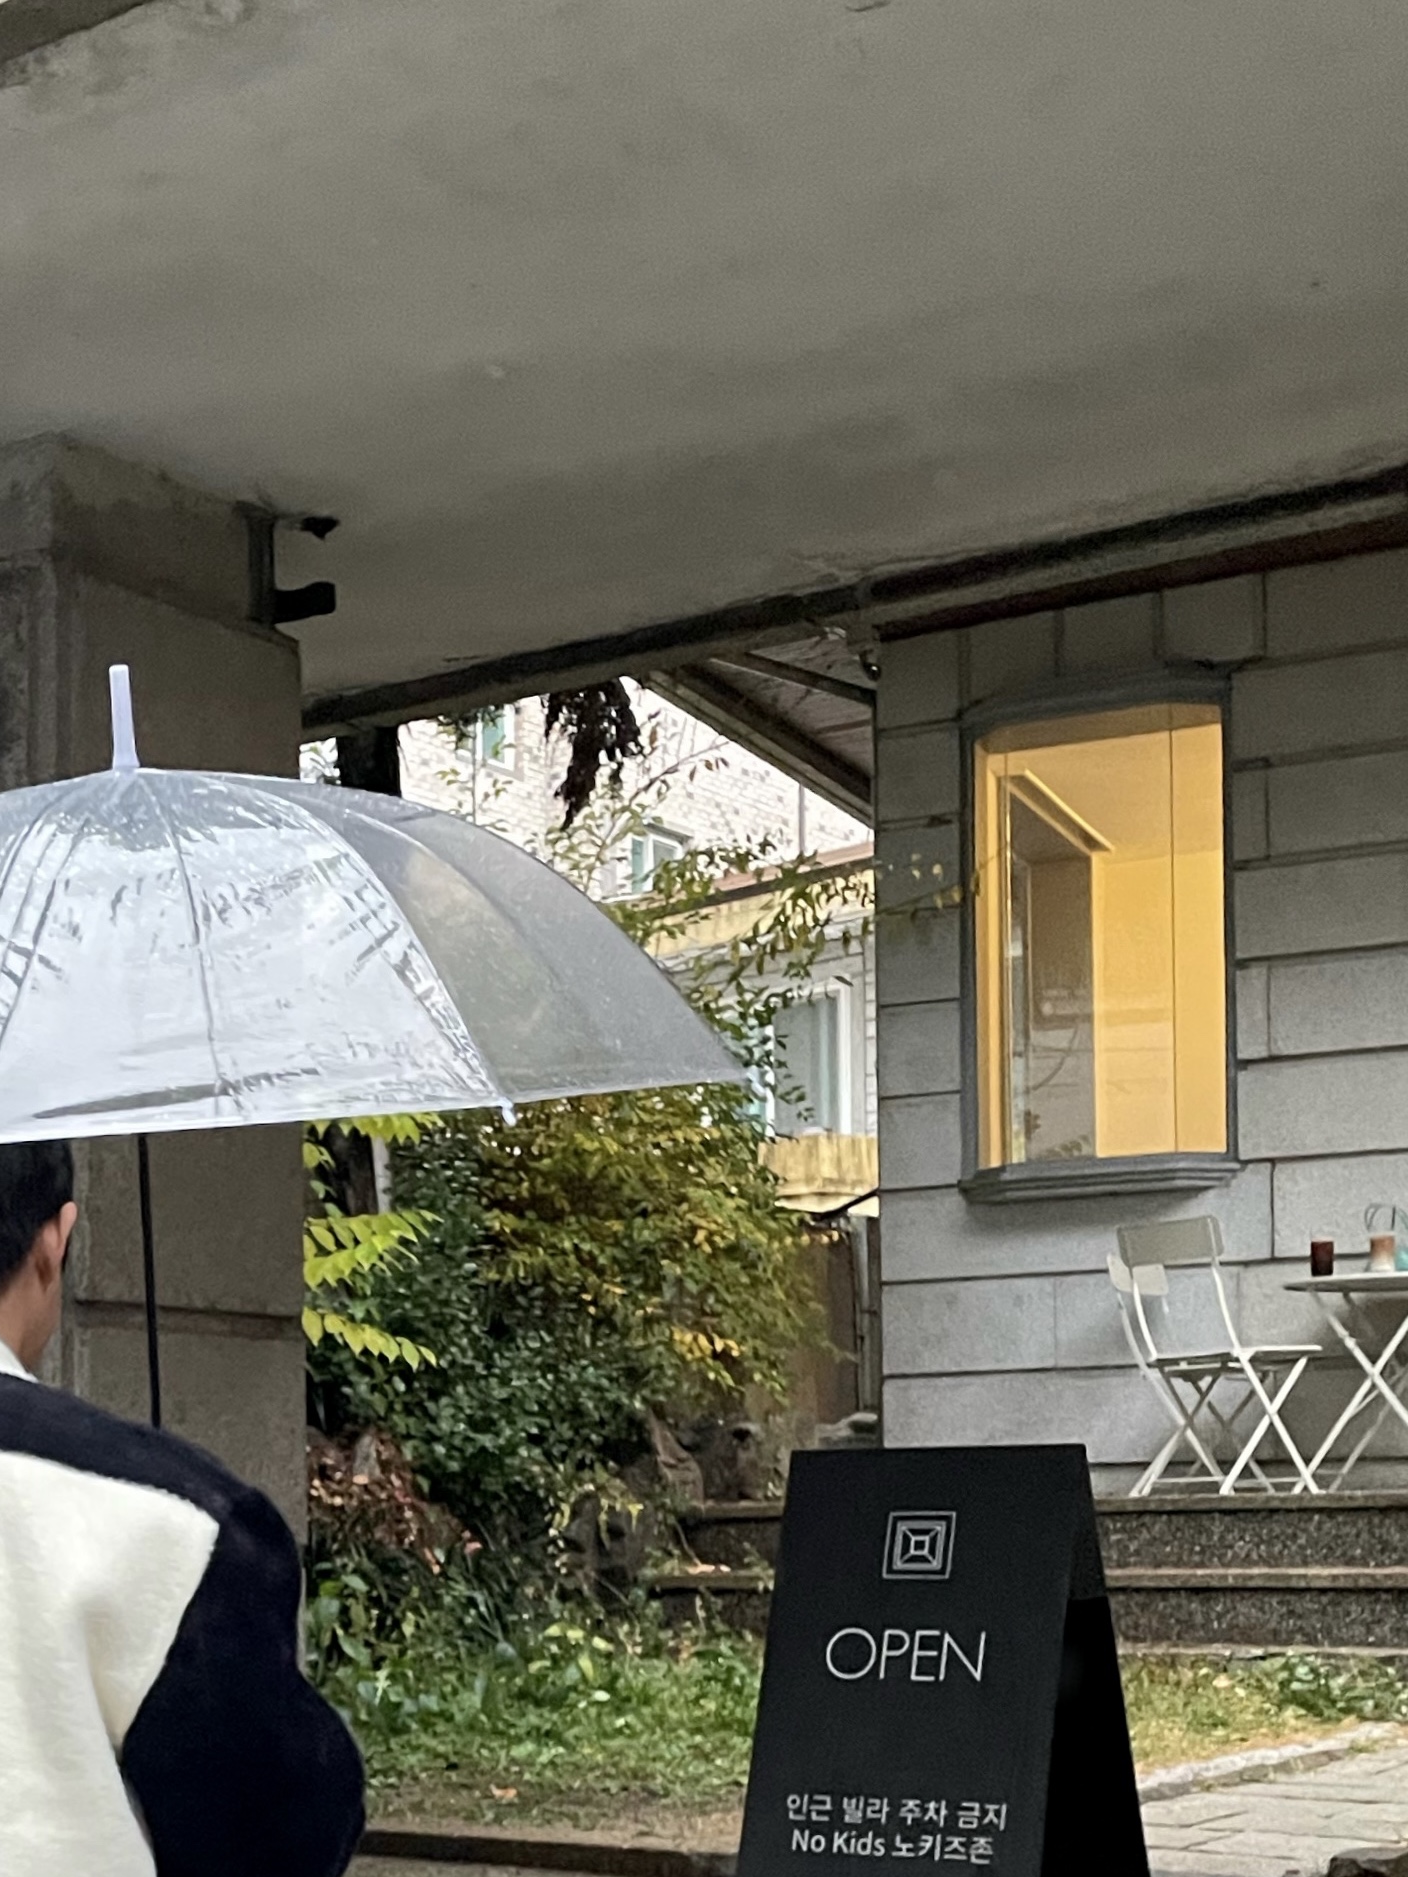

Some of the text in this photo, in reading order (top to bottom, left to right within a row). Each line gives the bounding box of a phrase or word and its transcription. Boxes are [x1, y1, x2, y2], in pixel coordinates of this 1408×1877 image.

[825, 1627, 987, 1682] OPEN
[786, 1793, 1008, 1832] 인근 빌라 주차 금지
[791, 1828, 994, 1865] No Kids 노키즈존
